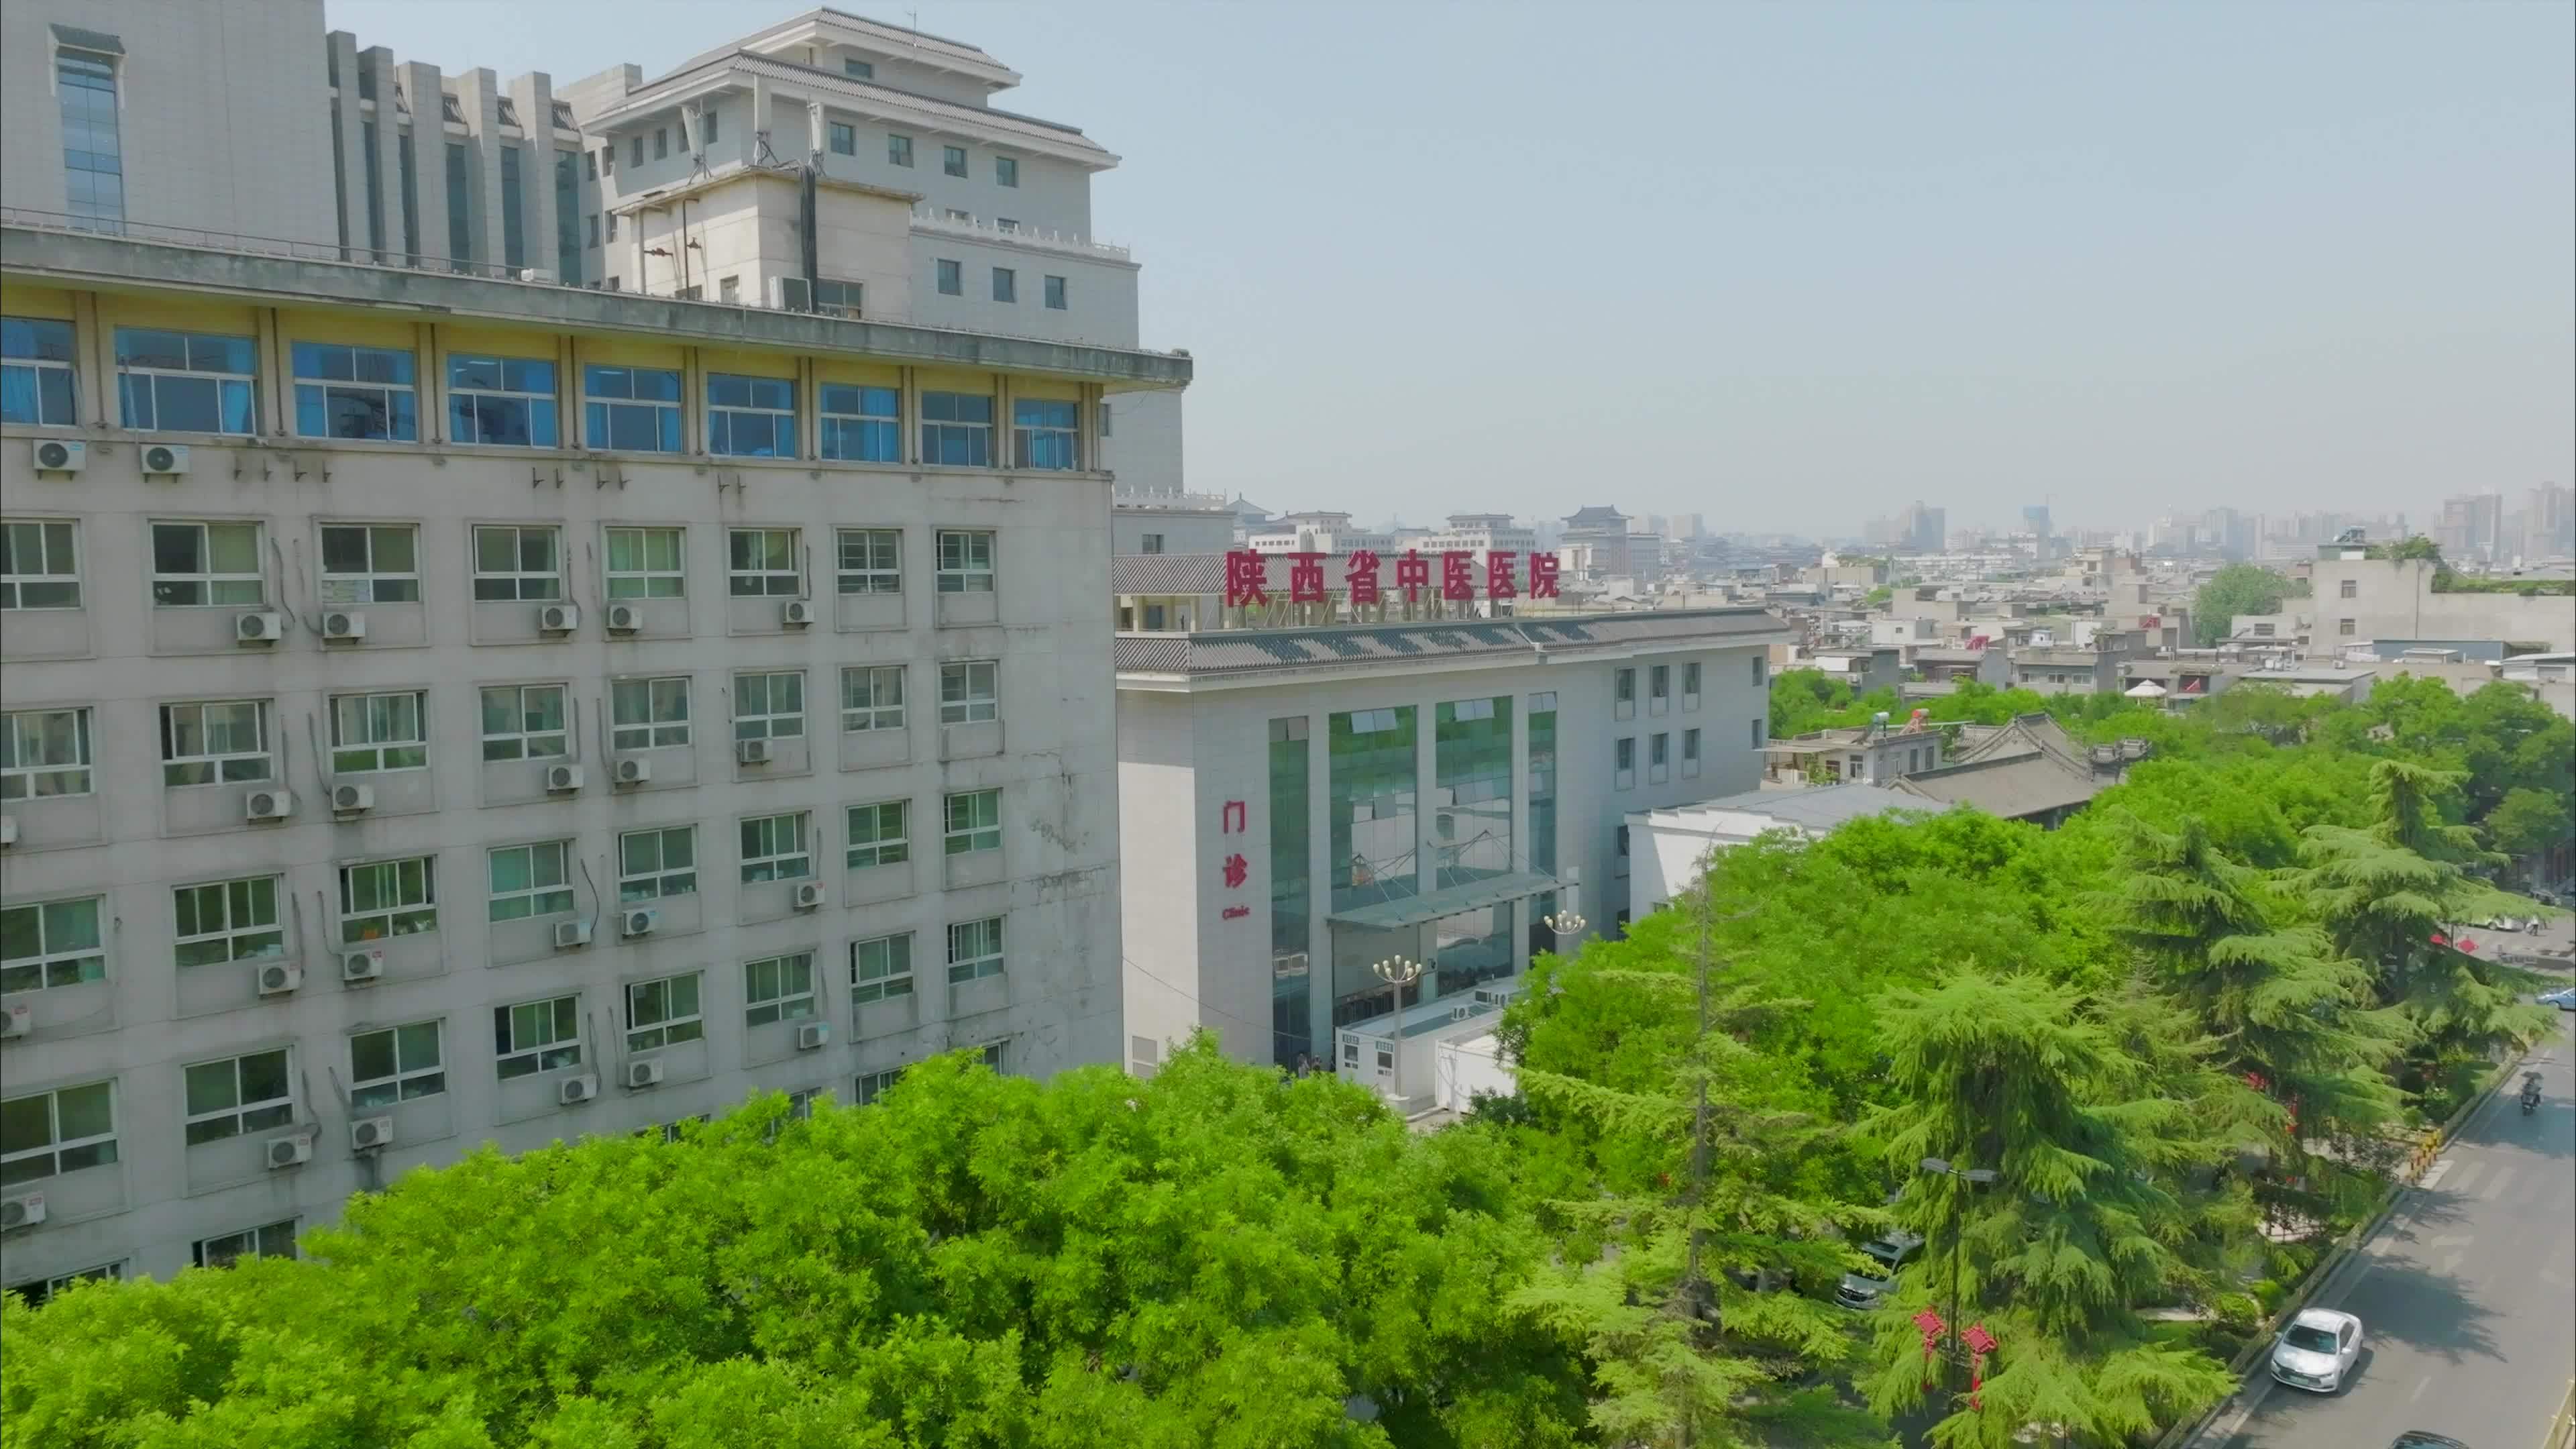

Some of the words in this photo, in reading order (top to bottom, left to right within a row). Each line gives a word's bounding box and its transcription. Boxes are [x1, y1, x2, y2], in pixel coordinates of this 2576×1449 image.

[1226, 549, 1560, 607] 陕西省中医医院
[1222, 800, 1247, 888] 门诊
[1222, 906, 1250, 920] Clinic
